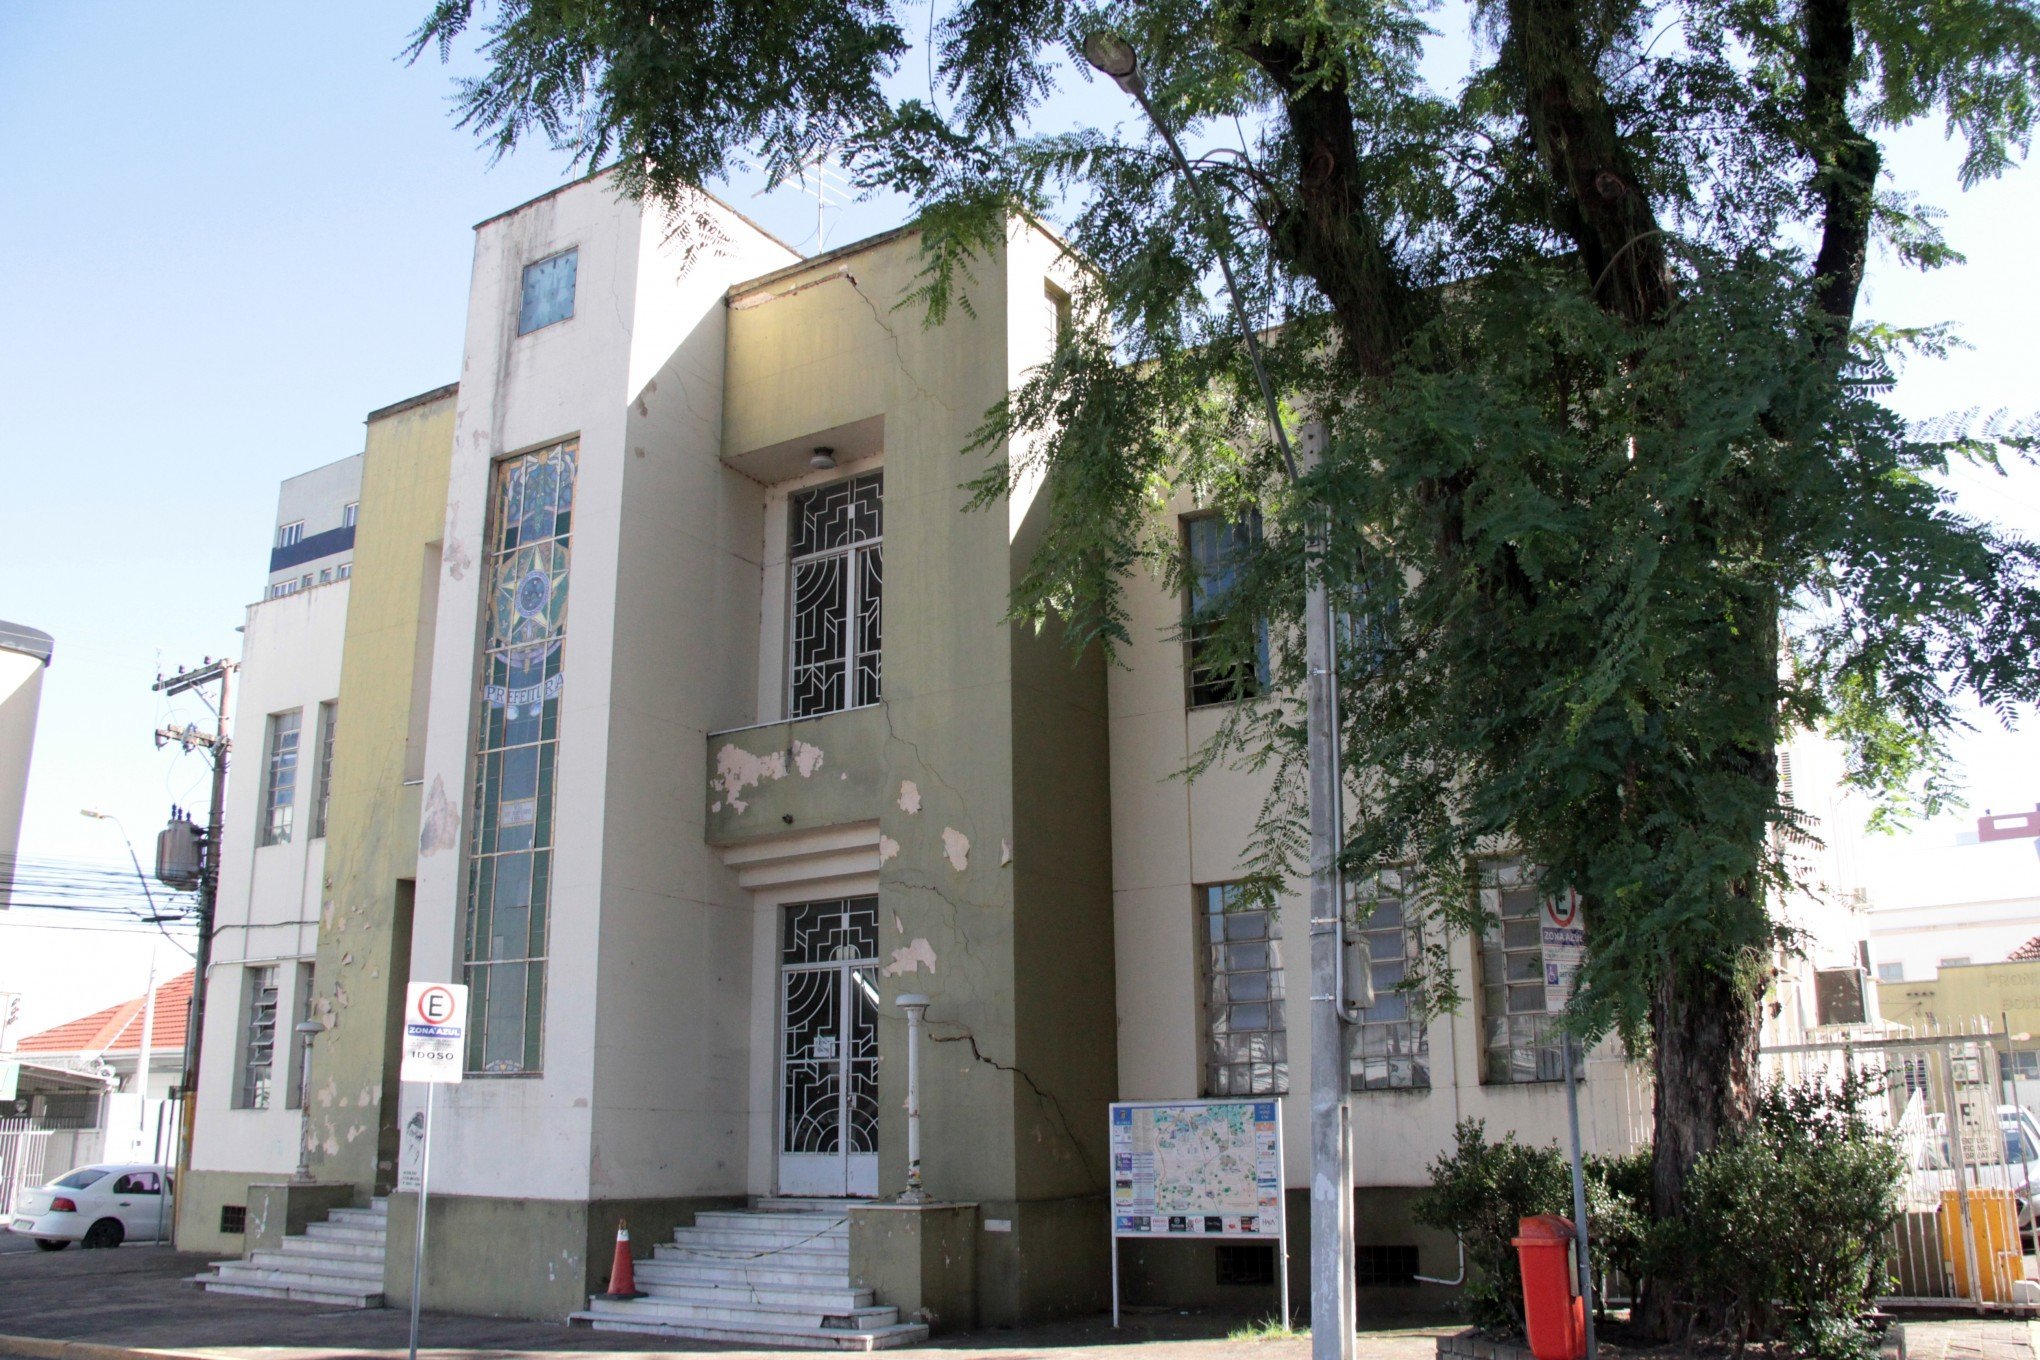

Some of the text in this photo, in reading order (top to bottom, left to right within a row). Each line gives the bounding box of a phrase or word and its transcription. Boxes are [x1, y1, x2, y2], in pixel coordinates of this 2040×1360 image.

[487, 673, 563, 704] PREFEITURA
[429, 995, 443, 1017] E
[409, 1026, 460, 1036] ZONA AZUL
[412, 1051, 454, 1060] IDOSO
